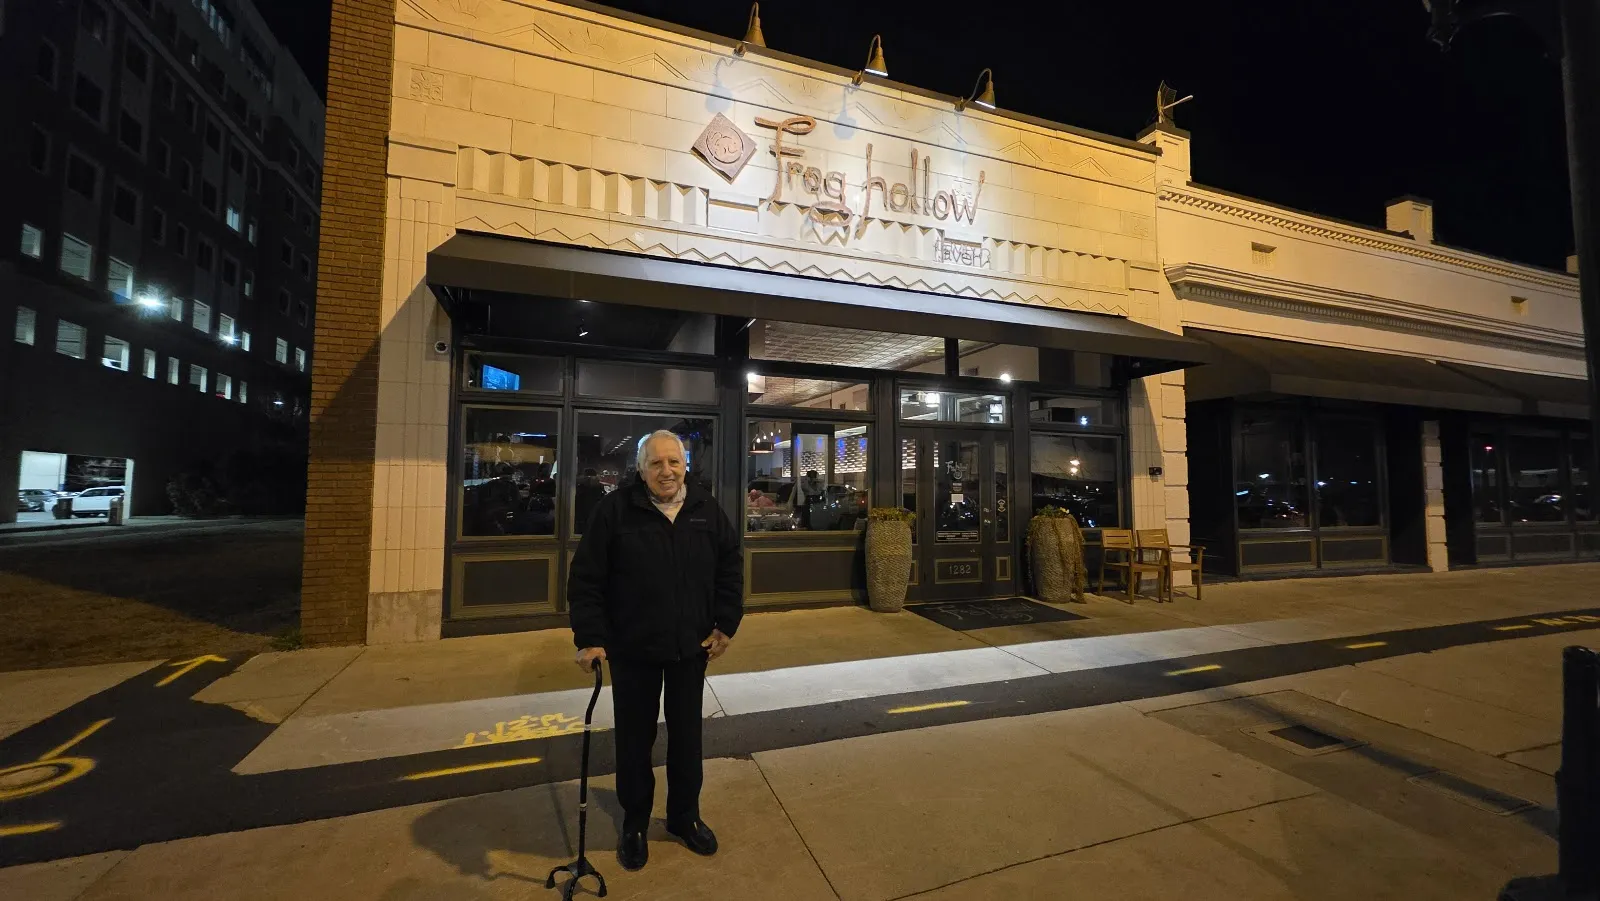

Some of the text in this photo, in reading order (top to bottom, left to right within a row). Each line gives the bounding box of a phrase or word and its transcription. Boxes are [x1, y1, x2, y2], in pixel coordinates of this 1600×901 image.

[754, 115, 986, 241] Frog hollow
[949, 564, 971, 574] 1282
